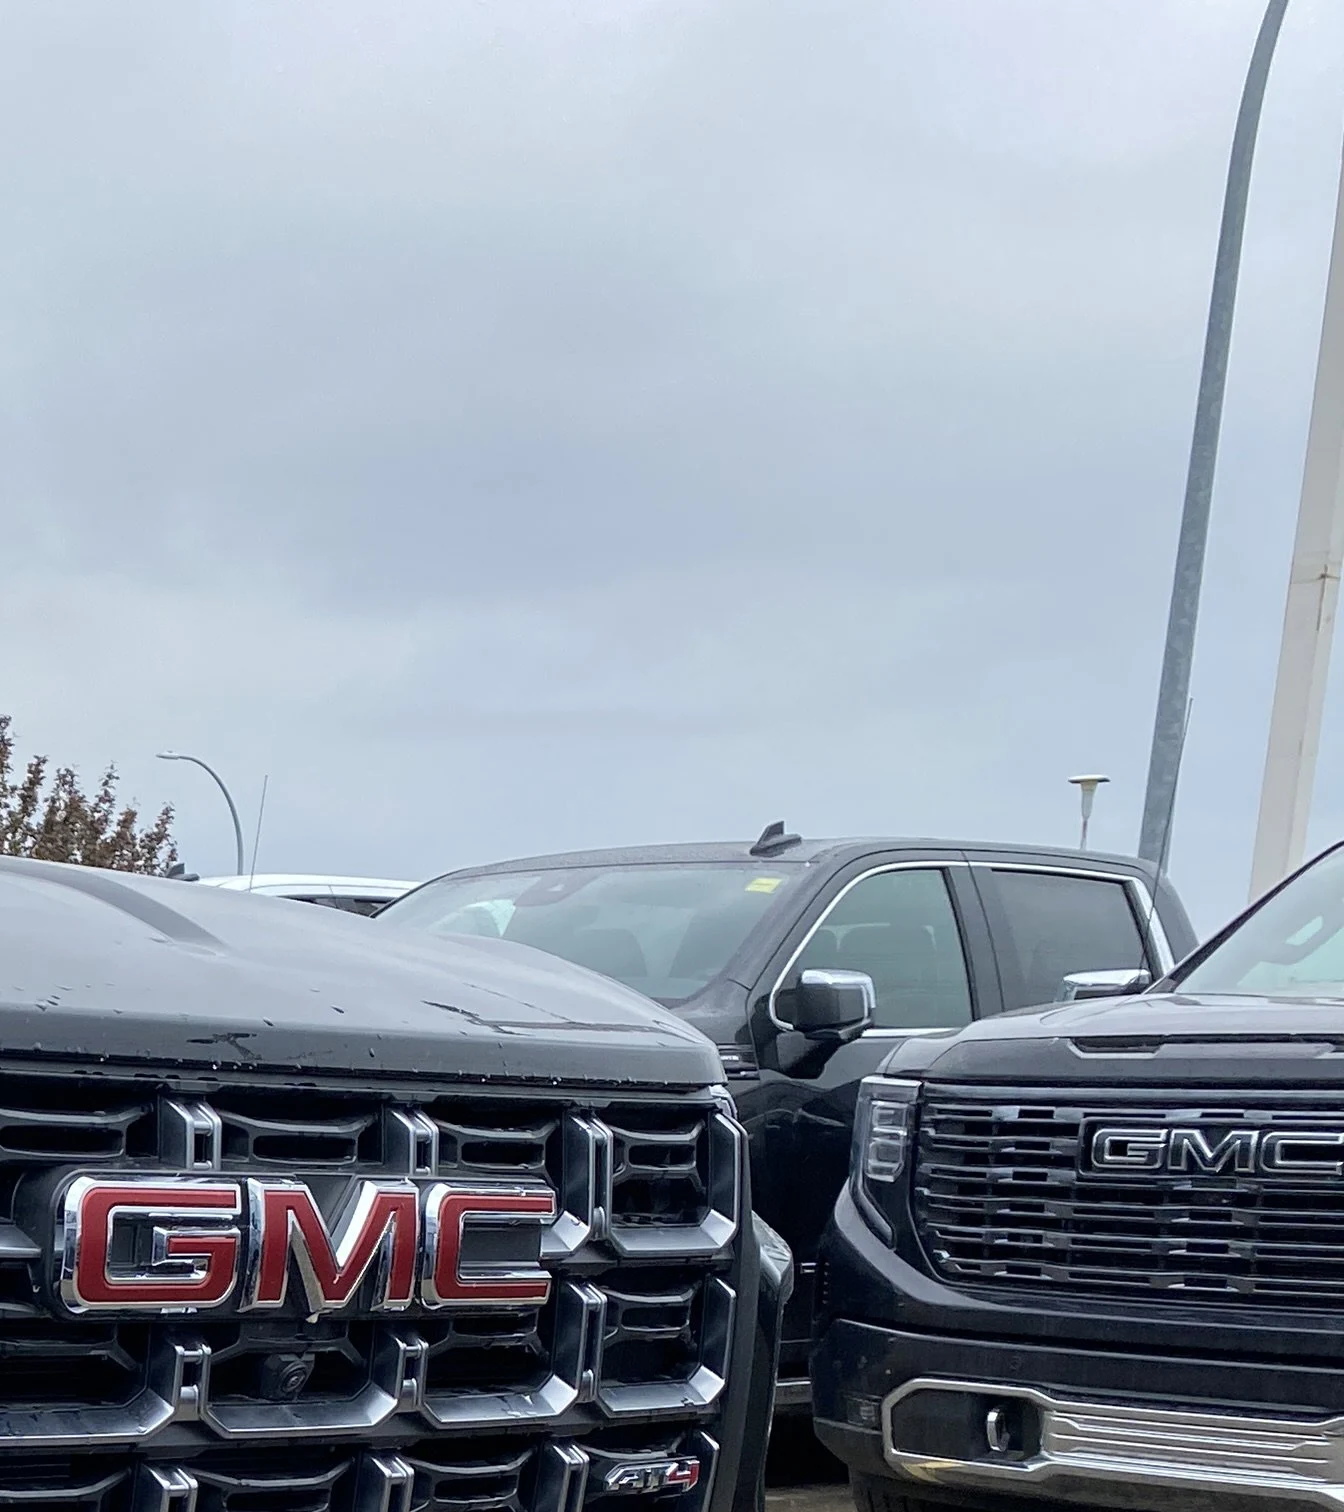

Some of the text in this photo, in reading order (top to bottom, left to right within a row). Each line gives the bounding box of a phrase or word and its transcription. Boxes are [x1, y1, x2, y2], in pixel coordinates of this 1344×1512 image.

[1091, 1129, 1344, 1175] GMC
[60, 1176, 556, 1322] GMC
[604, 1458, 701, 1493] AT4
